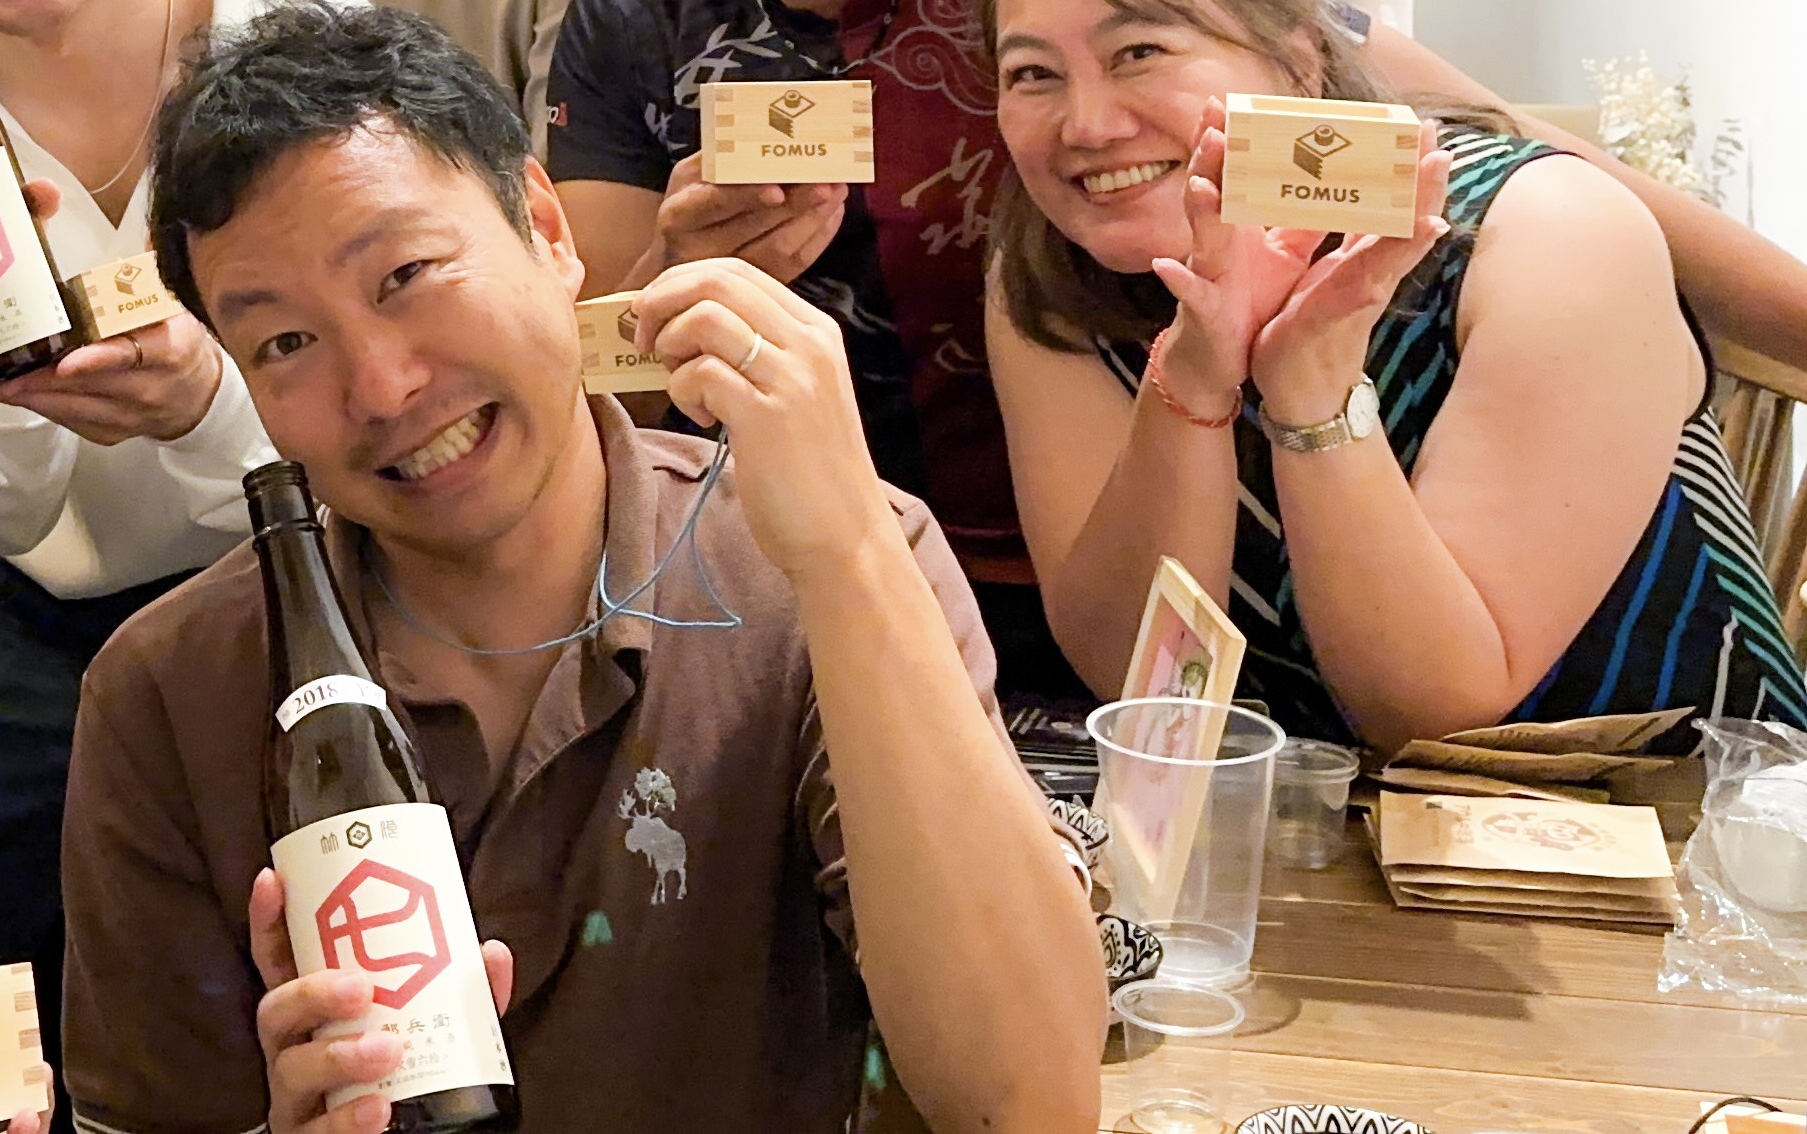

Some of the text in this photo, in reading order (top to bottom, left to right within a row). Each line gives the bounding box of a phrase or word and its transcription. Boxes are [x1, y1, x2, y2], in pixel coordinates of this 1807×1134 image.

[761, 143, 827, 157] FOMUS
[1280, 183, 1360, 204] FOMUS
[118, 293, 159, 314] FOMUS
[615, 354, 662, 367] FOMU
